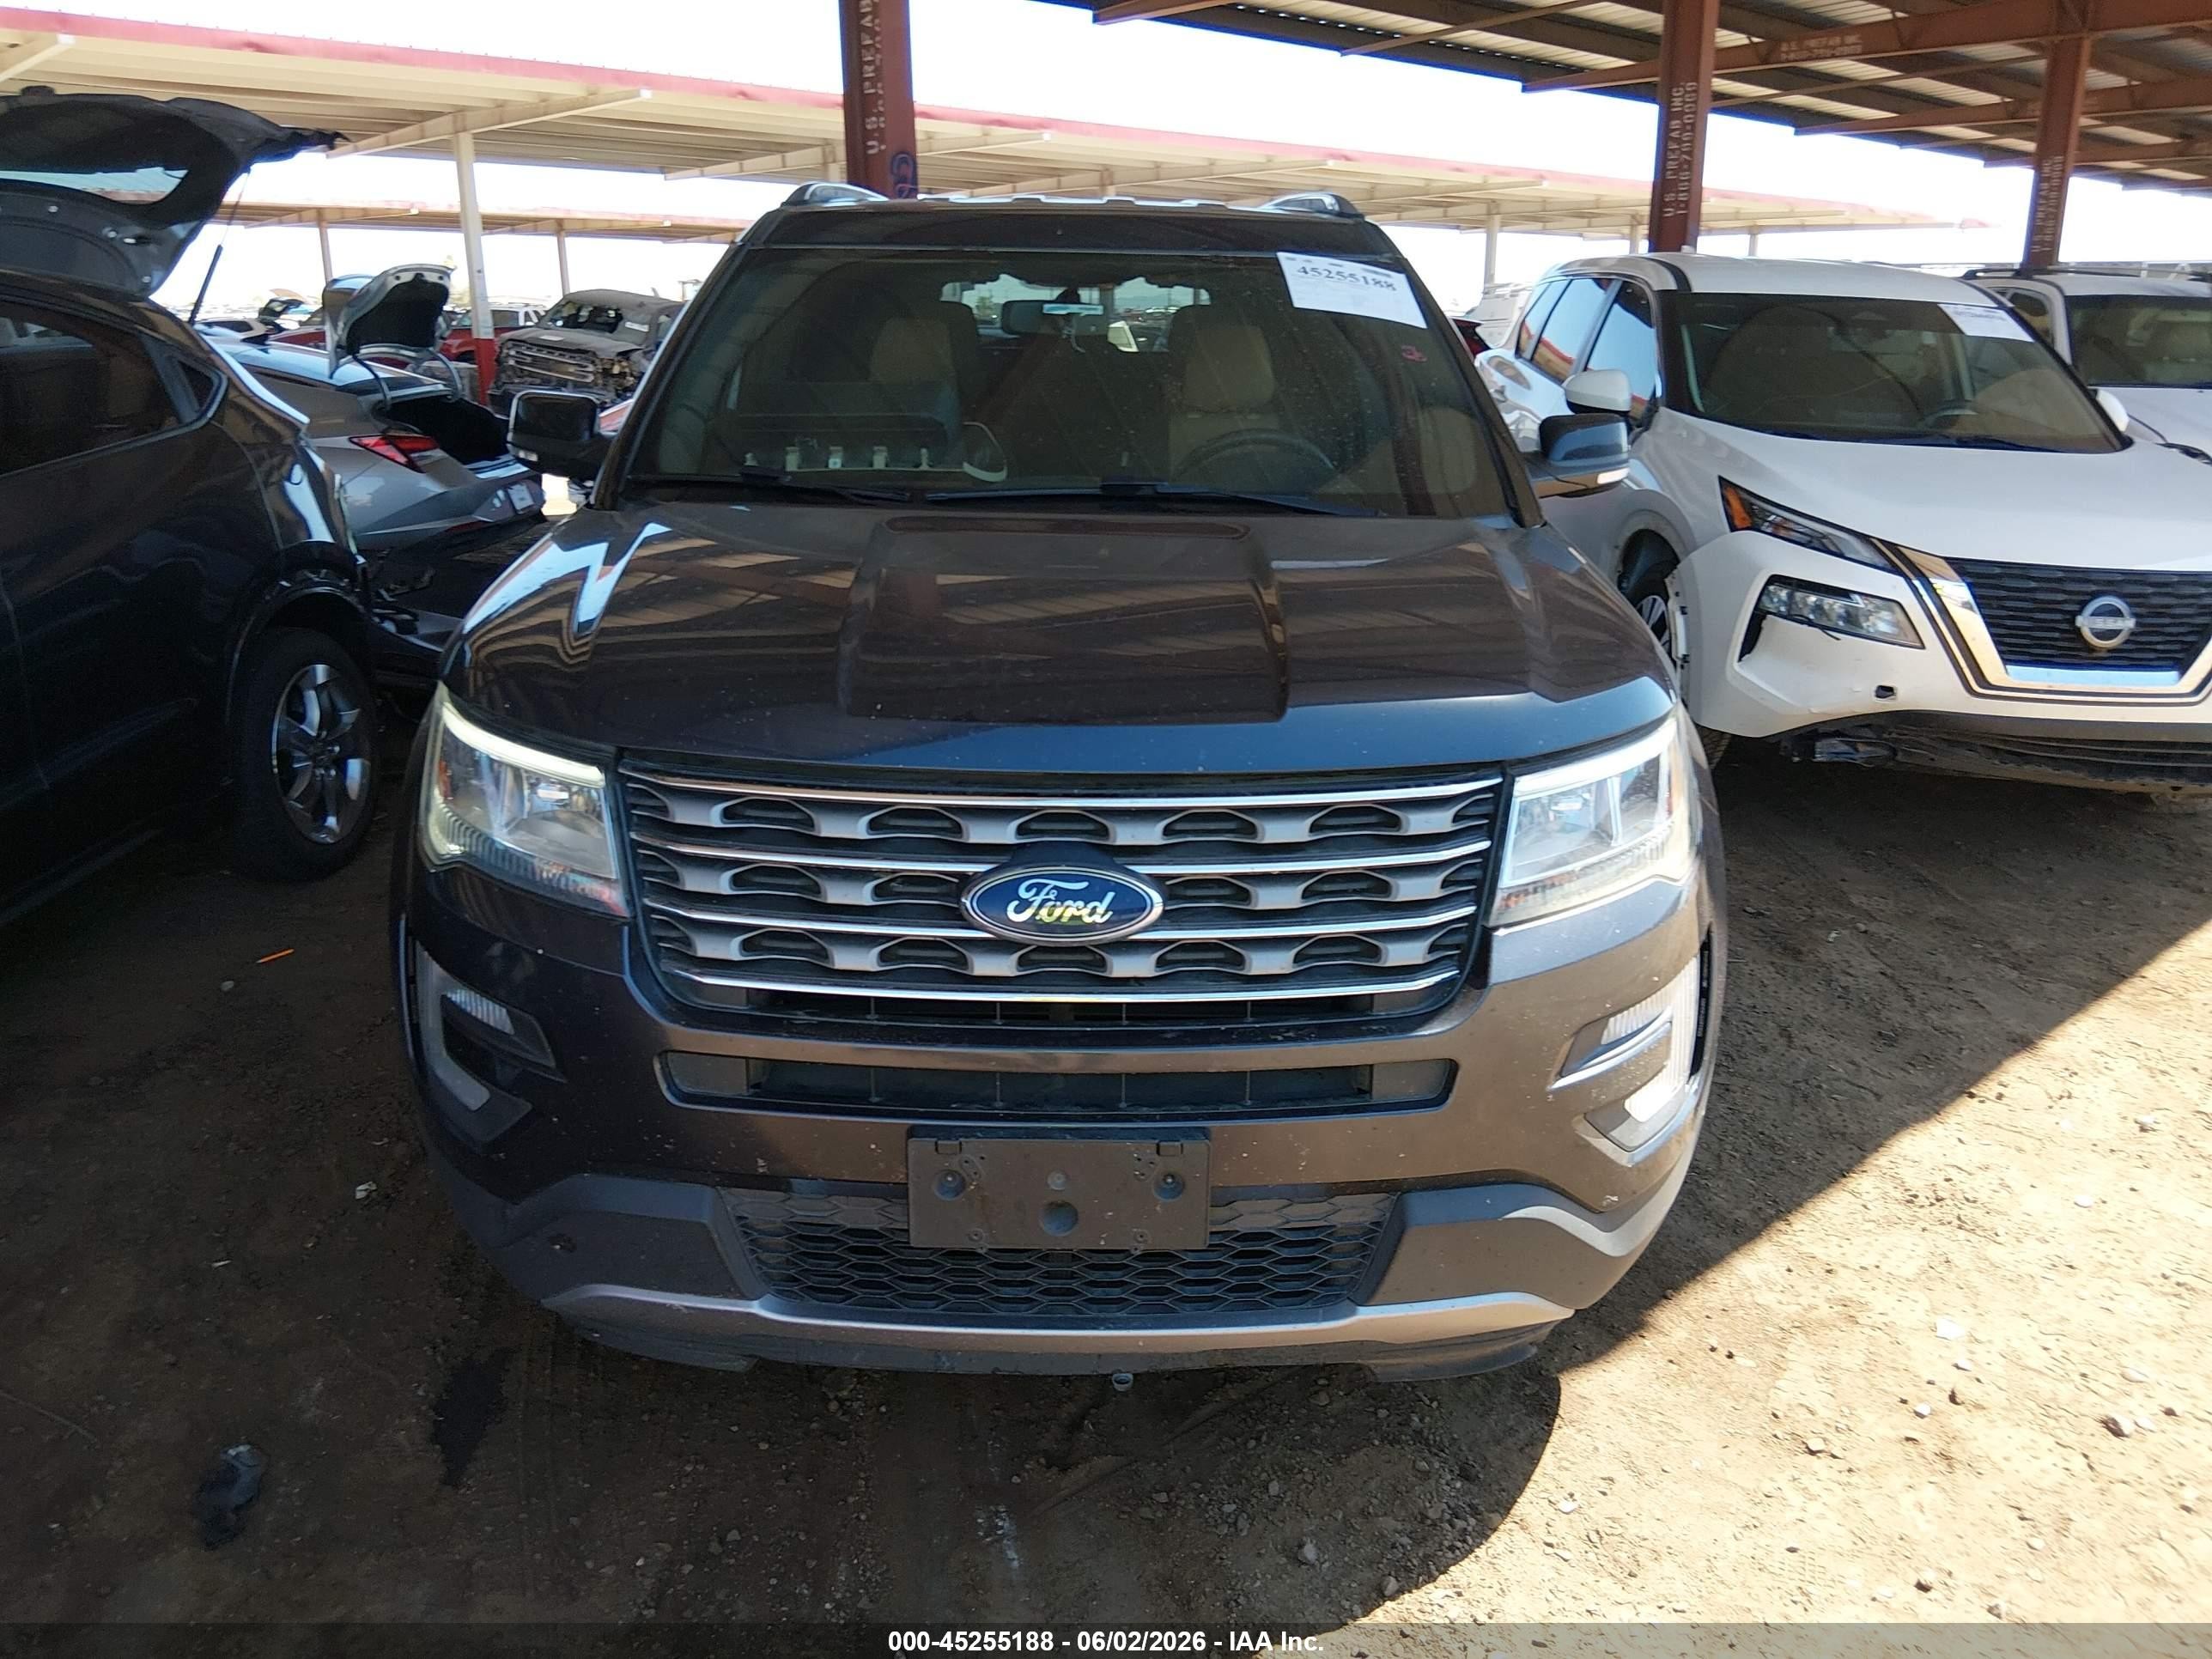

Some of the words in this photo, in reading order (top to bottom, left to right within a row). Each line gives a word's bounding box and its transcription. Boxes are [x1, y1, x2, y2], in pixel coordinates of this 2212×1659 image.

[1665, 119, 1682, 179] PREFAB
[1297, 265, 1397, 291] 45255188
[1006, 878, 1115, 924] Ford
